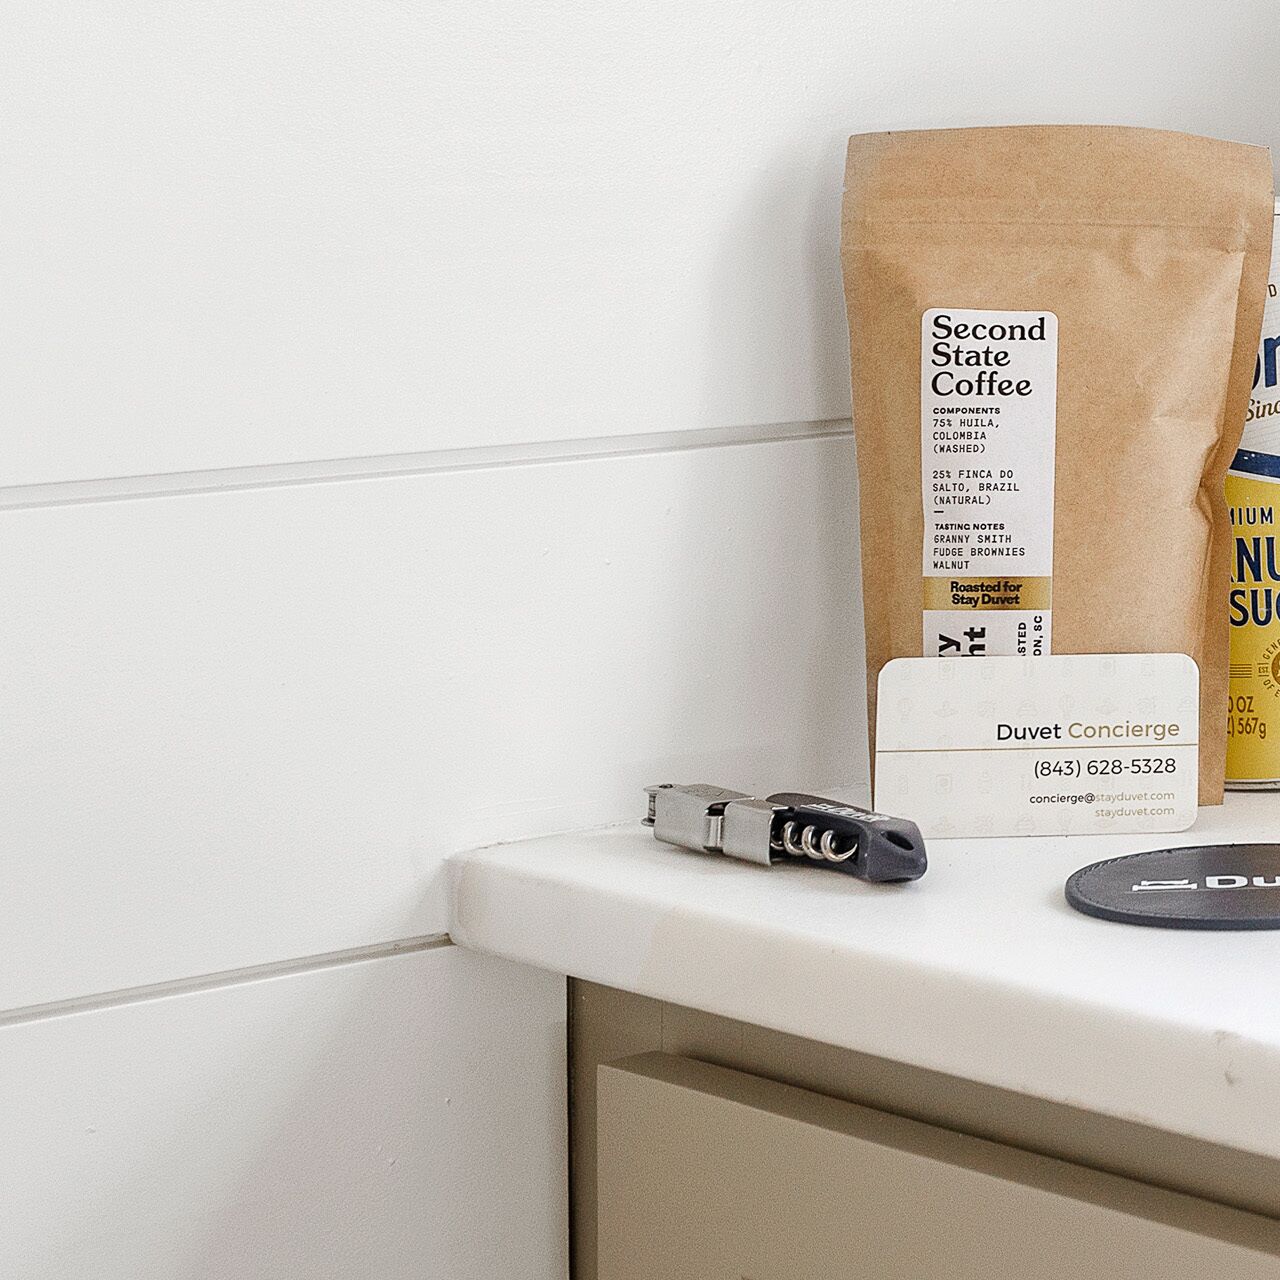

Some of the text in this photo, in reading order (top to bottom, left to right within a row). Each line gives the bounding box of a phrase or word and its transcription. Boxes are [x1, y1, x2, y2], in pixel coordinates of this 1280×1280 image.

[932, 314, 1046, 340] Second
[931, 342, 1011, 367] State
[931, 371, 1033, 396] Coffee
[933, 407, 1001, 415] COMPONENTS
[933, 419, 1000, 428] 75% HUILA,
[933, 432, 987, 440] COLOMBIA
[933, 444, 986, 453] (WASHED)
[932, 470, 1014, 479] 25% FINCA DO
[932, 483, 1020, 493] SALTO, BRAZIL
[933, 495, 991, 505] (NATURAL)
[935, 523, 1005, 531] TASTING NOTES
[934, 535, 1012, 544] GRANNY SMITH
[933, 548, 1025, 557] FUDGE BROWNIES
[933, 561, 970, 569] WALNUT
[950, 581, 1022, 593] Roasted for
[951, 594, 1020, 608] Stay Duvet
[1033, 615, 1043, 631] SC
[1263, 679, 1275, 690] OF
[1236, 696, 1254, 713] OZ
[997, 721, 1180, 741] Duvet Concierge
[1237, 717, 1267, 740] 567g
[1034, 758, 1177, 779] (843) 628-5328
[1029, 792, 1175, 805] concierge@stayduvet.com
[1095, 807, 1175, 819] stayduvet.com
